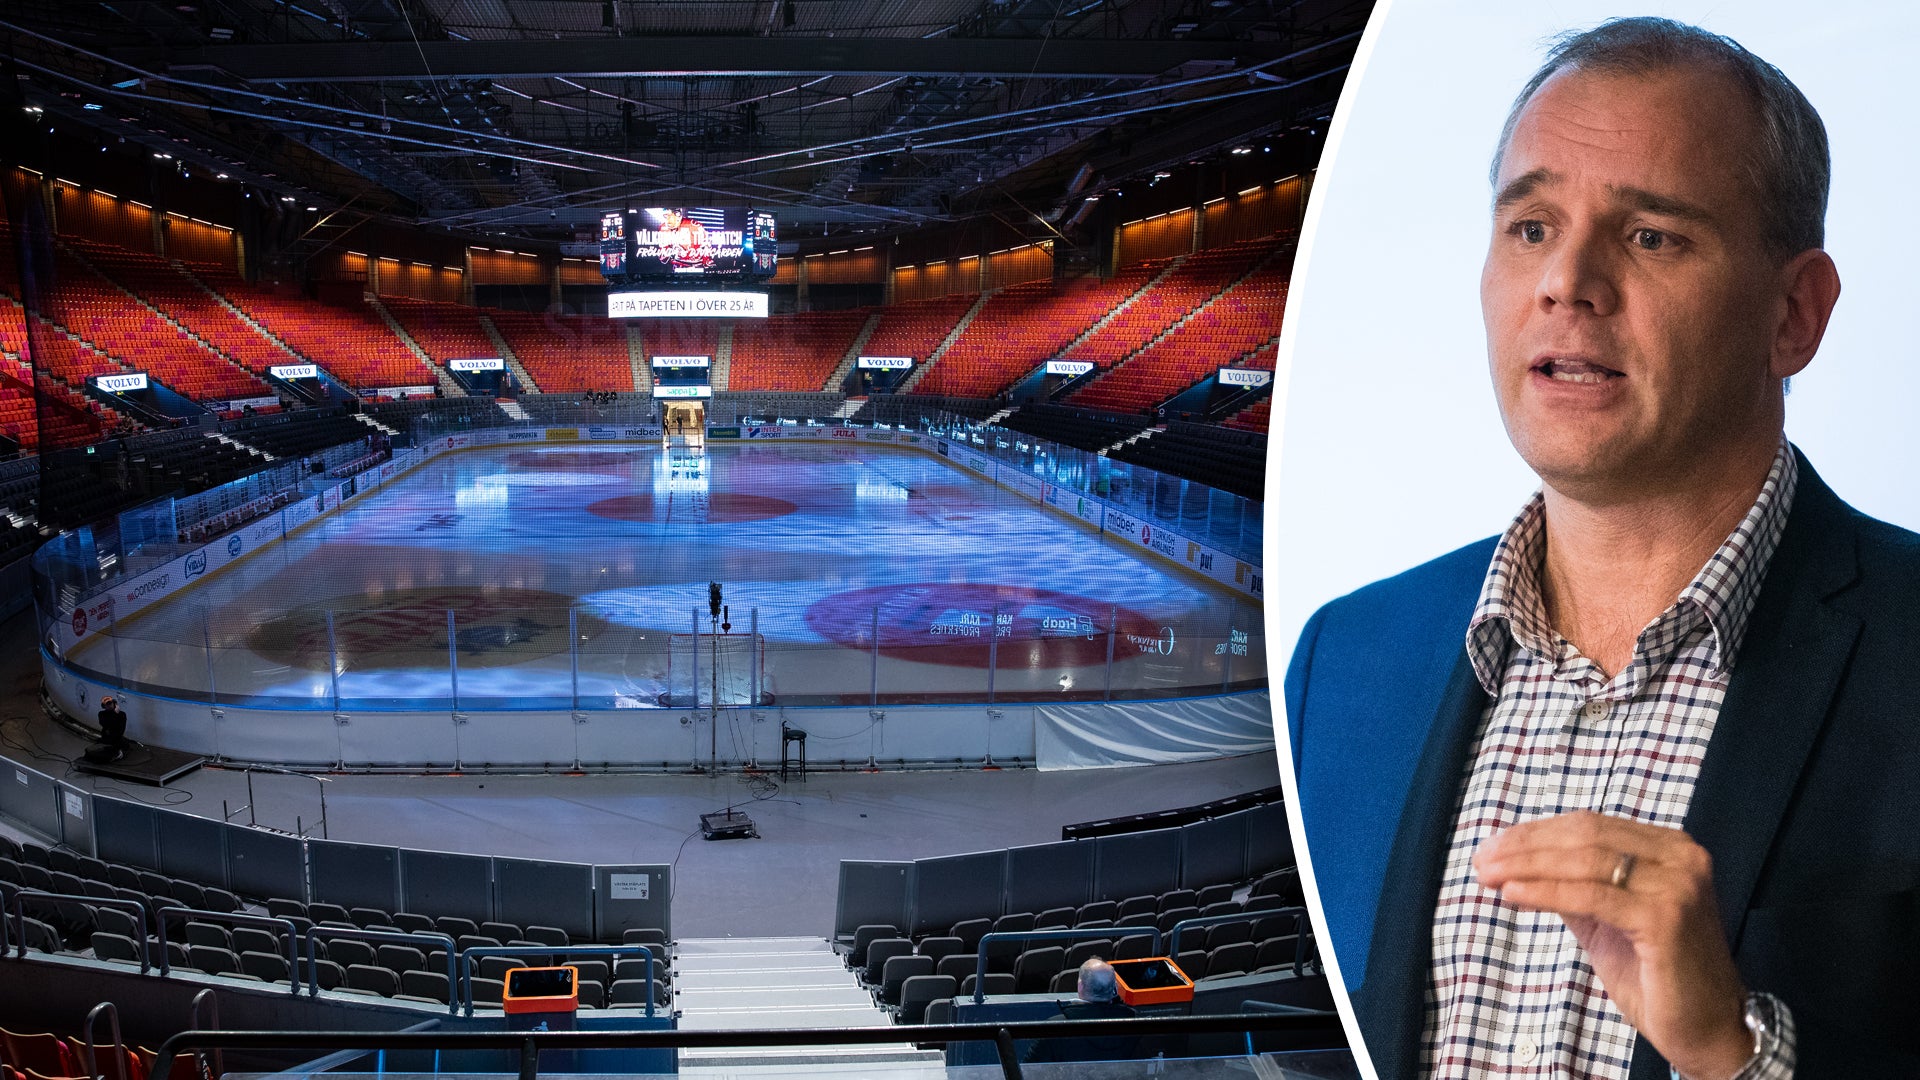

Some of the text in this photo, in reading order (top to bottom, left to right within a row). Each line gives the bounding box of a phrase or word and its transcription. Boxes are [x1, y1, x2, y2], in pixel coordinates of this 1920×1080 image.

[625, 299, 636, 311] PÅ
[638, 300, 686, 311] TAPETEN
[696, 298, 727, 311] ÖVER
[729, 300, 741, 311] 25
[743, 299, 754, 311] ÅR
[279, 367, 311, 376] VOLVO
[1054, 363, 1087, 372] VOLVO
[106, 377, 140, 389] VOLVO
[1227, 372, 1262, 383] VOLVO
[625, 427, 660, 436] midbec
[833, 430, 856, 438] JULA
[1152, 527, 1176, 546] TURKISH
[1151, 540, 1175, 557] AIRLINES
[1200, 552, 1213, 571] put
